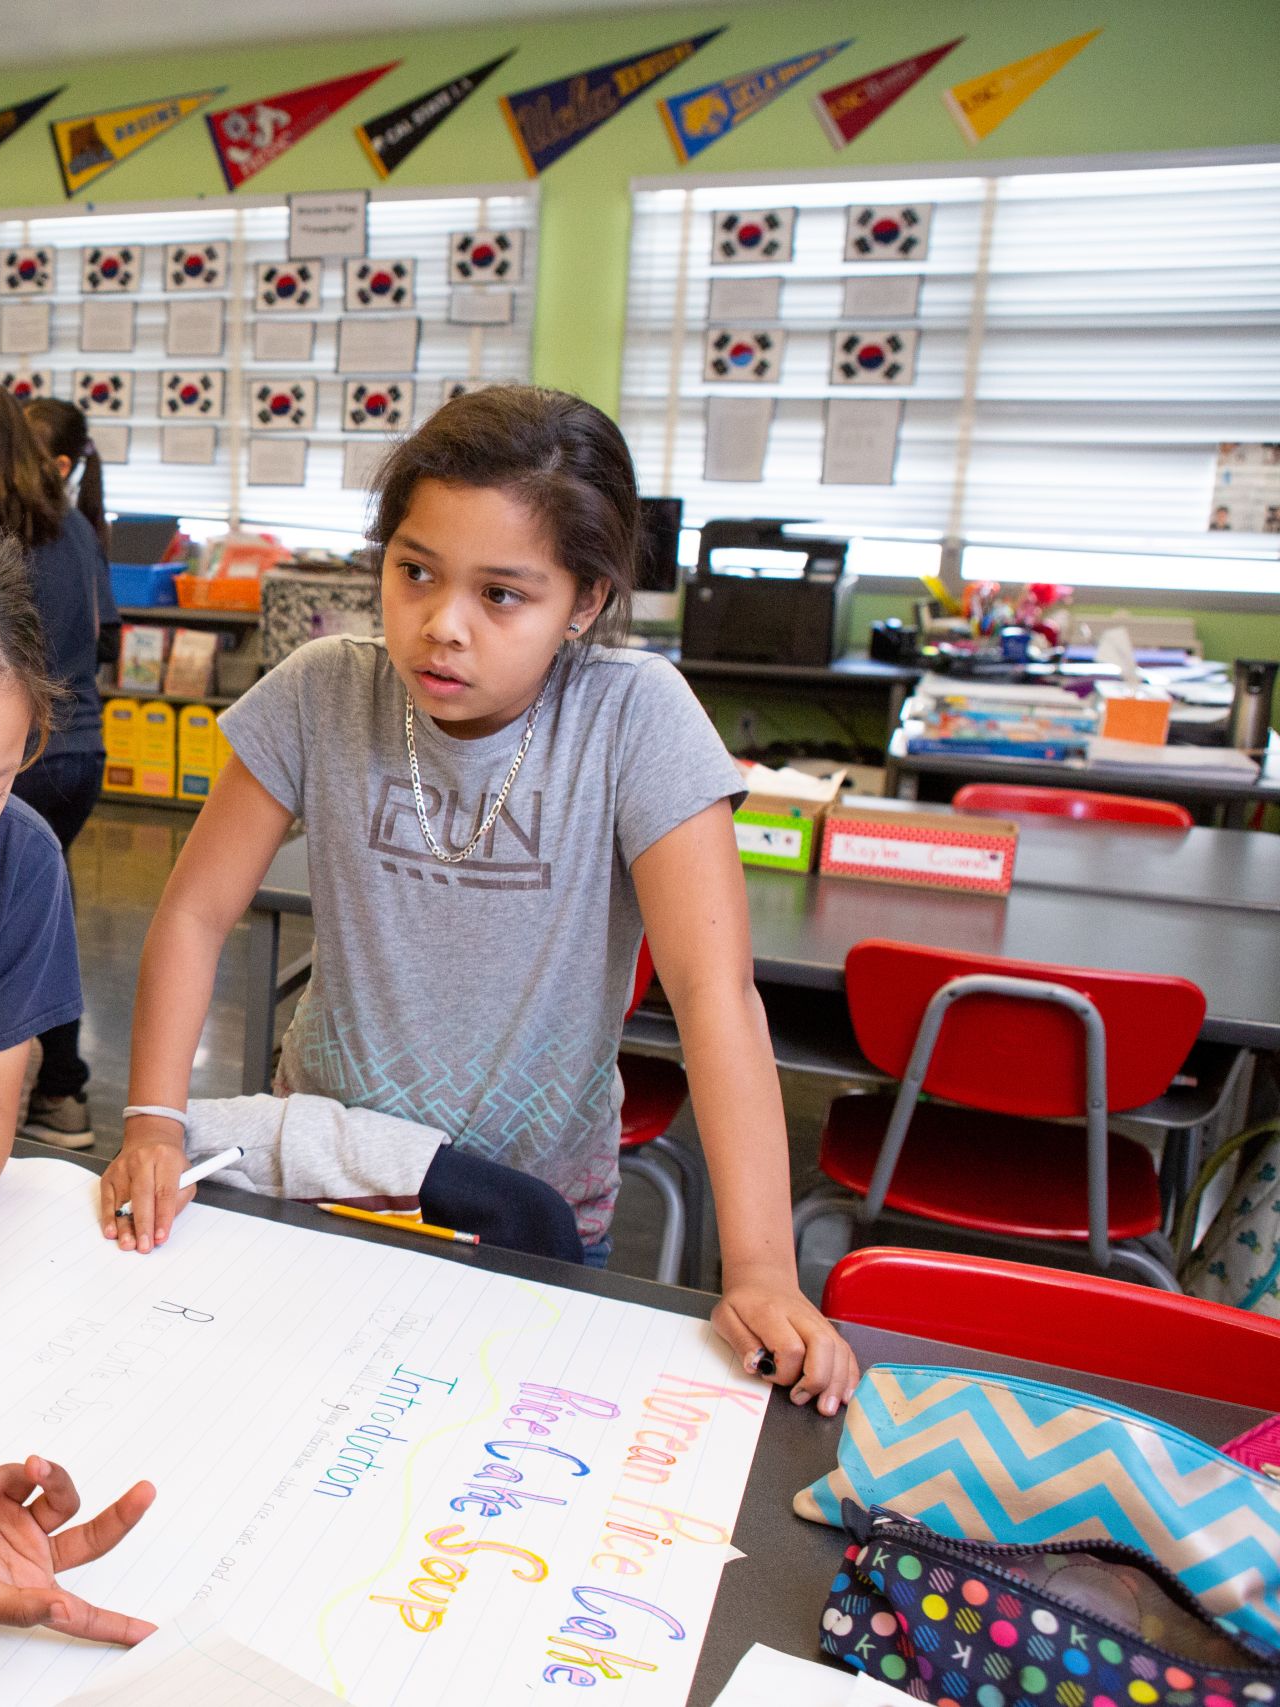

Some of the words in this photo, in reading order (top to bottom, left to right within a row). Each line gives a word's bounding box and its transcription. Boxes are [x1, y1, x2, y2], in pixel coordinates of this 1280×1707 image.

[369, 775, 543, 859] RUN
[313, 1363, 459, 1498] Introduction
[503, 1381, 621, 1437] Rice
[622, 1373, 764, 1484] Korean
[450, 1440, 591, 1518] Cake
[369, 1523, 549, 1633] Soup
[591, 1494, 731, 1577] Rice
[542, 1585, 686, 1687] Cake
